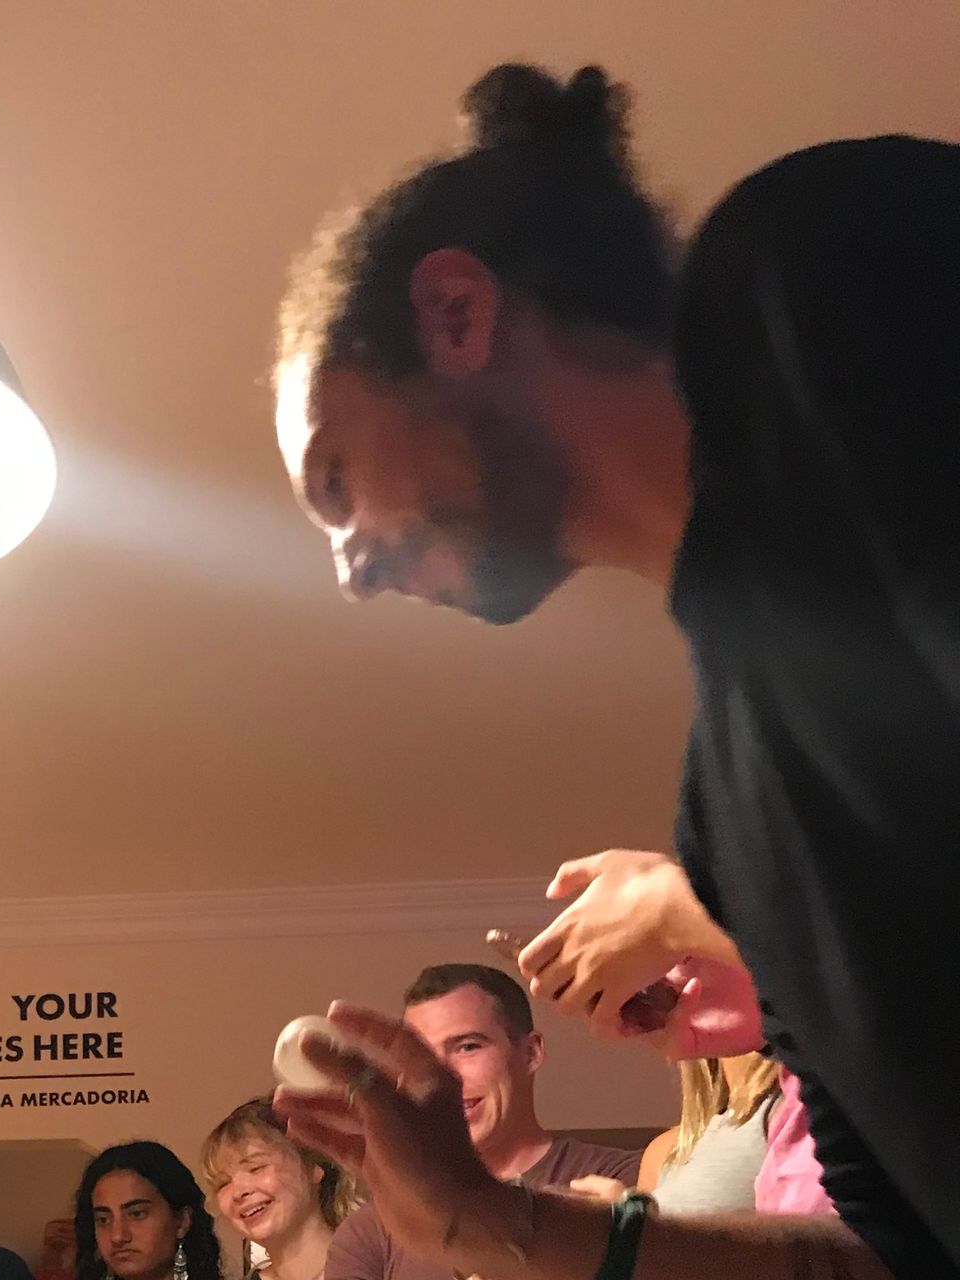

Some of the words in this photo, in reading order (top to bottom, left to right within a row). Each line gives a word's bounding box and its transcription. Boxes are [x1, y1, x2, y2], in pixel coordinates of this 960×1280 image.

[11, 991, 119, 1021] YOUR
[33, 1031, 124, 1061] HERE
[19, 1088, 151, 1108] MERCADORIA
